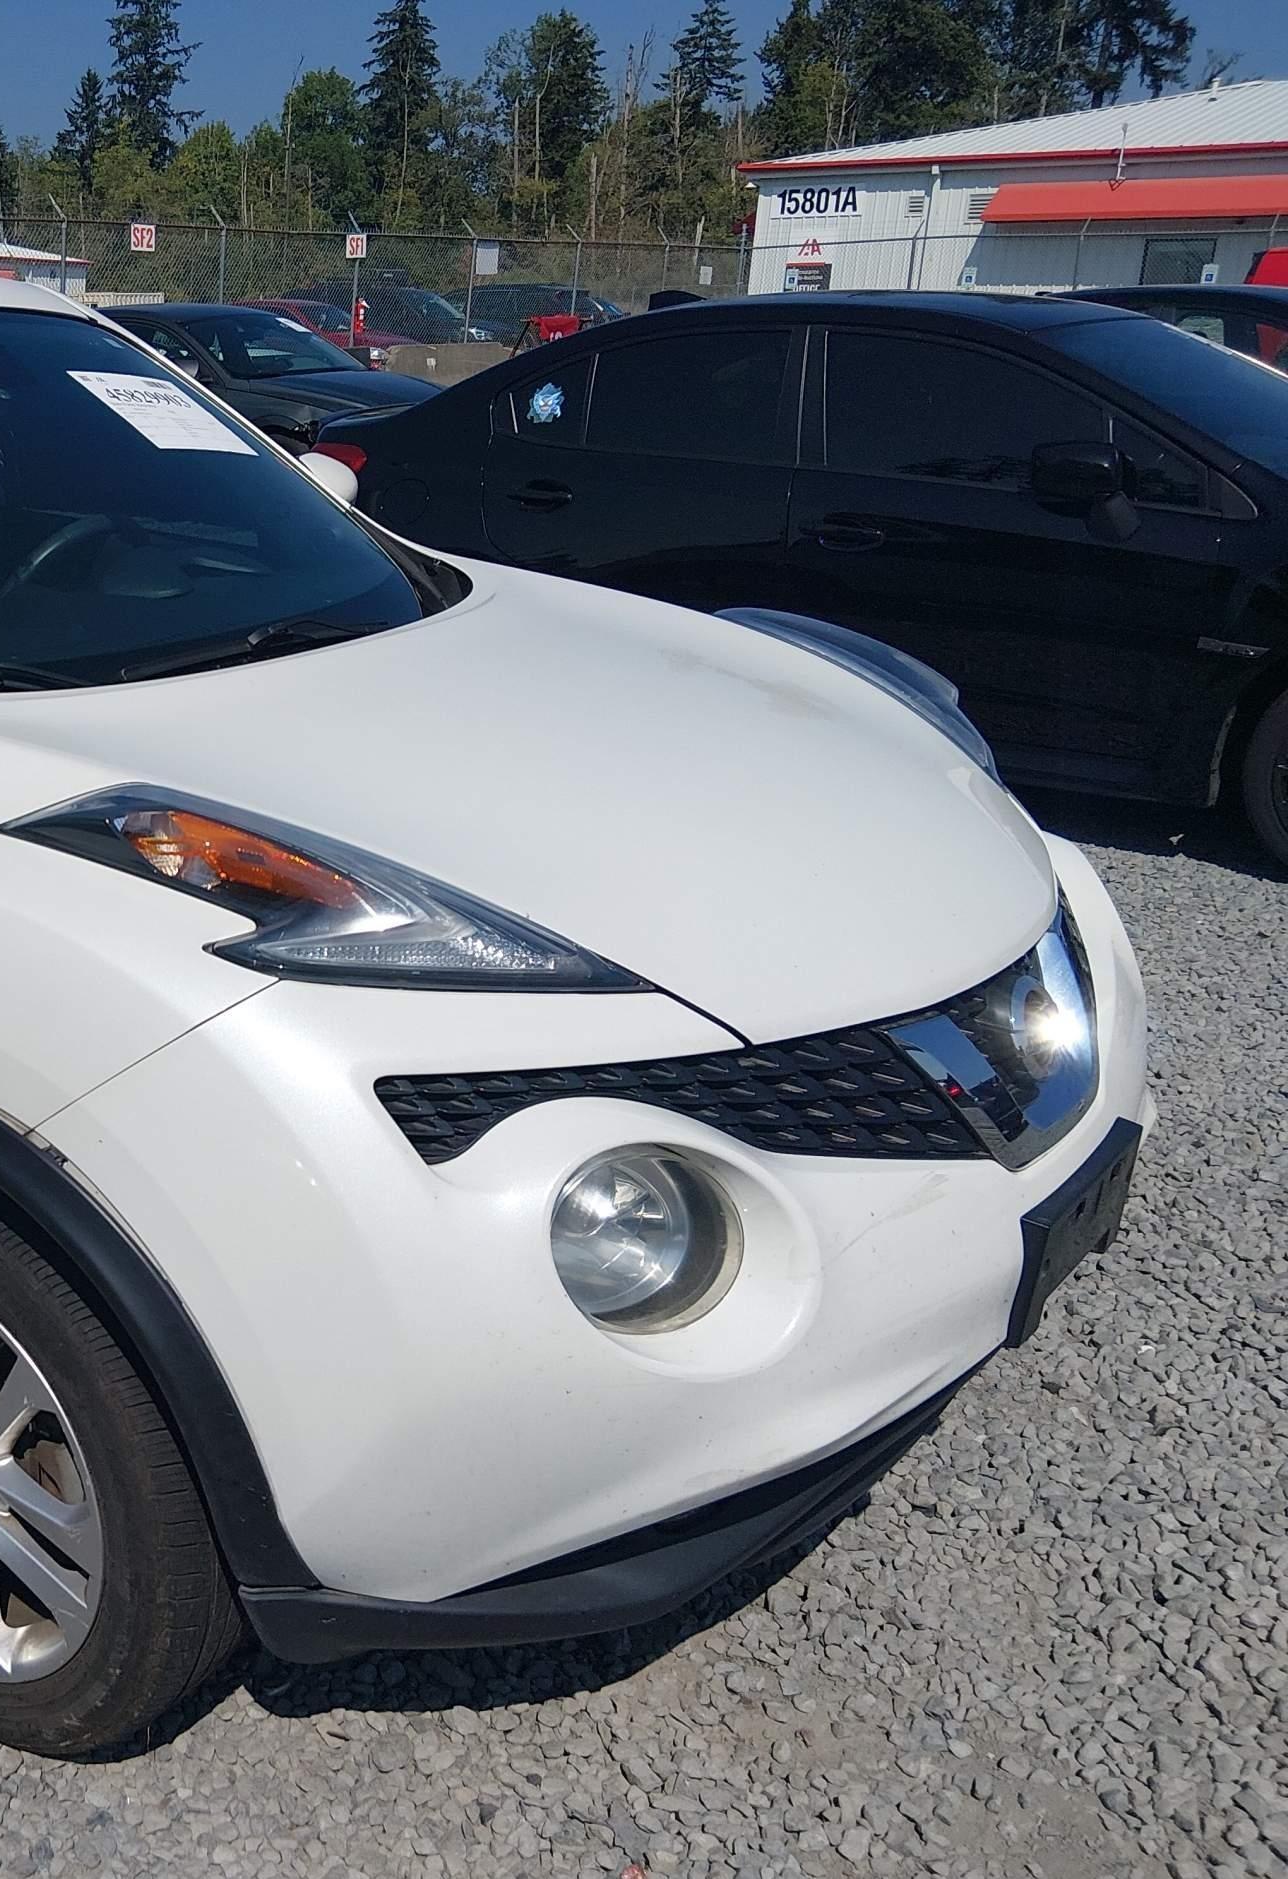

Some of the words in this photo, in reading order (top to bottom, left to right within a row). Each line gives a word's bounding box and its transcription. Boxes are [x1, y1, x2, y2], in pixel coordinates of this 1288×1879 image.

[777, 186, 858, 215] 15801A
[133, 226, 153, 248] SF2
[349, 237, 363, 256] SF1
